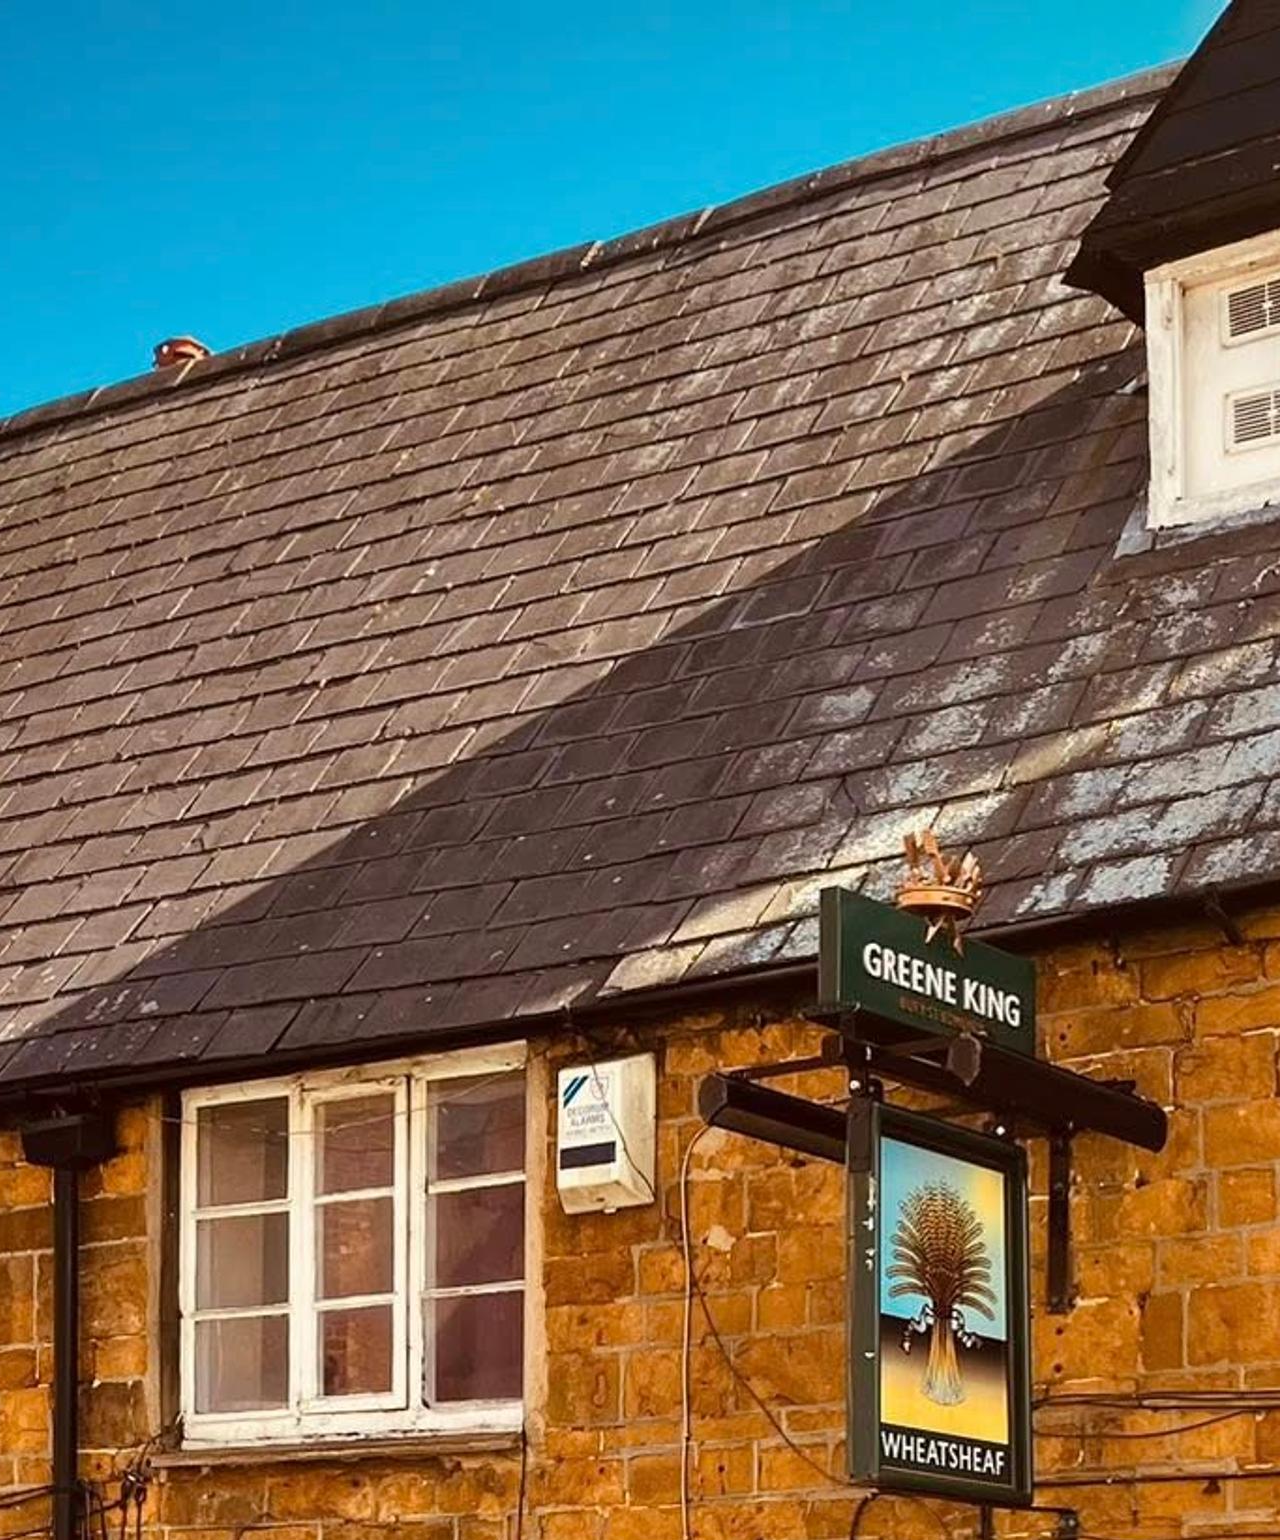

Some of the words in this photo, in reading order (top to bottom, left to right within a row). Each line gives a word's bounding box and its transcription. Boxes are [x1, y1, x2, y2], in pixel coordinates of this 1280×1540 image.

[863, 943, 957, 1004] GREENE
[963, 978, 1021, 1027] KING
[880, 1430, 1005, 1476] WHEATSHEAF
